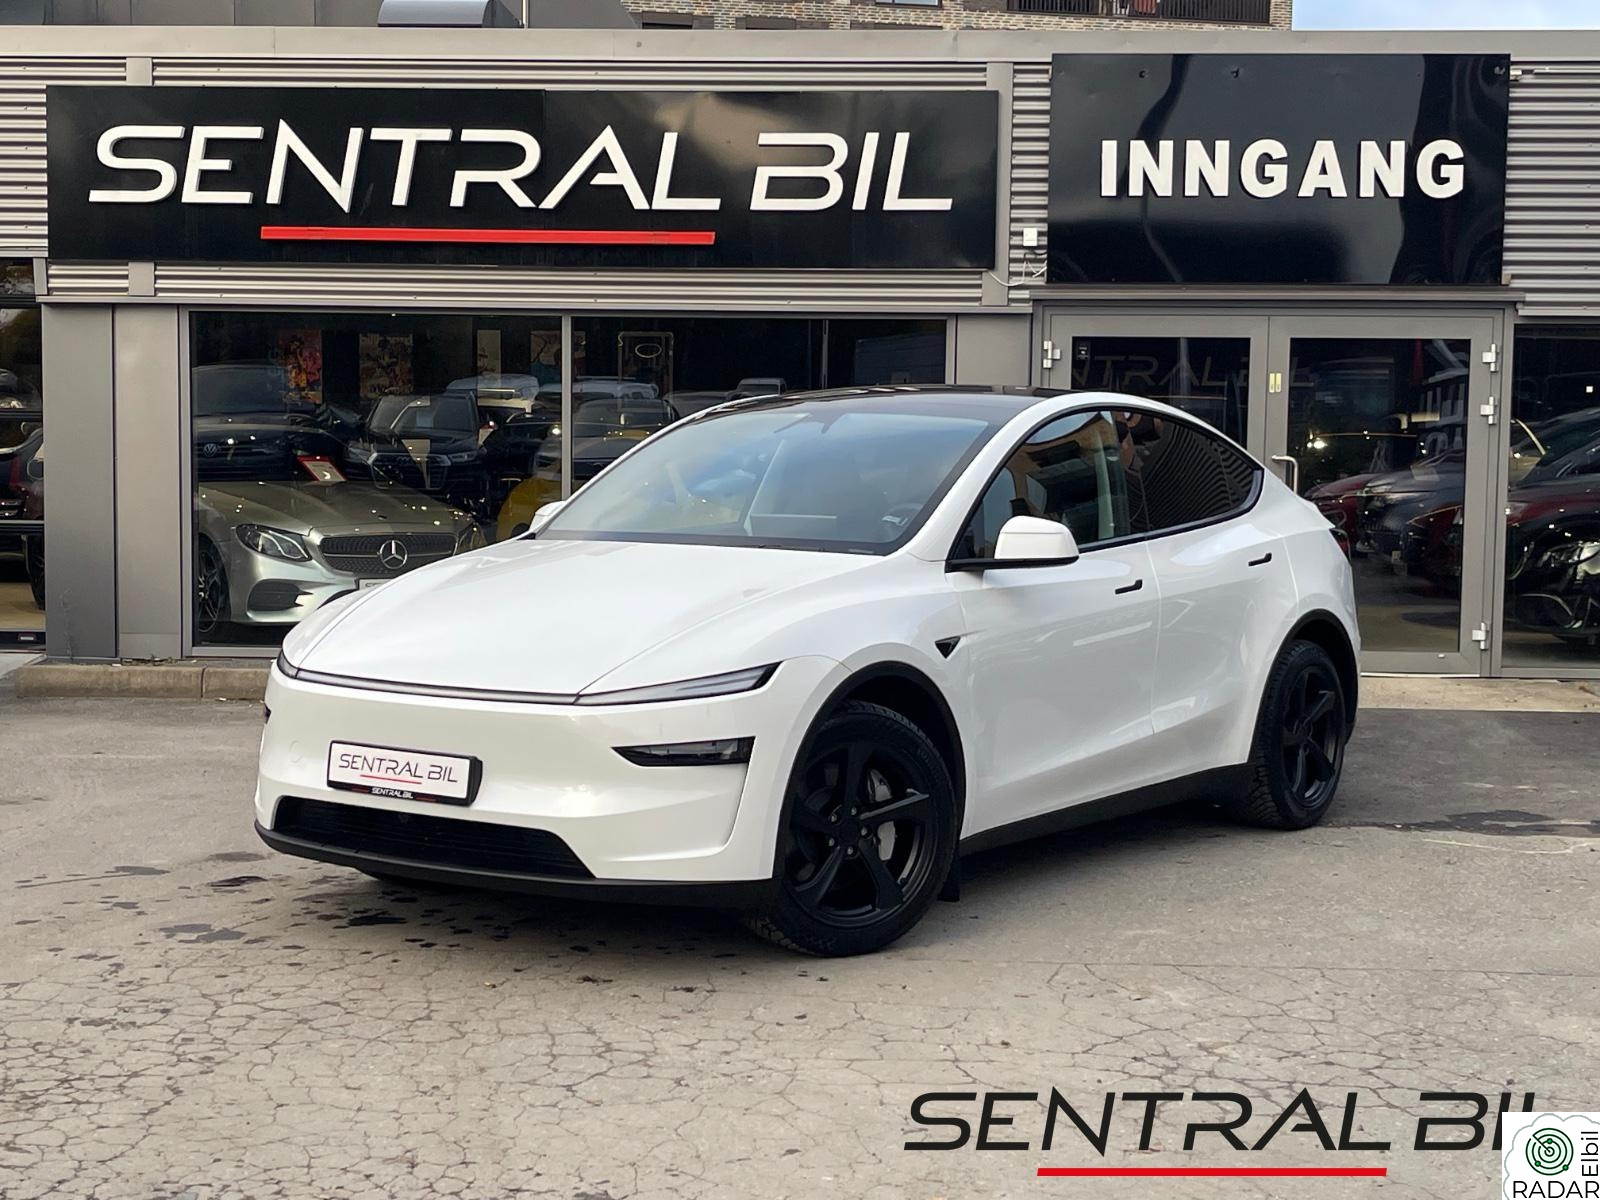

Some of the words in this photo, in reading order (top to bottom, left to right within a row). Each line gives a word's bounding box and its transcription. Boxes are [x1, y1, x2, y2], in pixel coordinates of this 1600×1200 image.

[88, 118, 721, 213] SENTRAL
[749, 131, 953, 211] BIL
[1101, 138, 1465, 199] INNGANG
[339, 753, 423, 779] SENTRAL
[427, 764, 458, 783] BIL
[371, 786, 401, 798] SENTRAL
[402, 791, 414, 799] BIL
